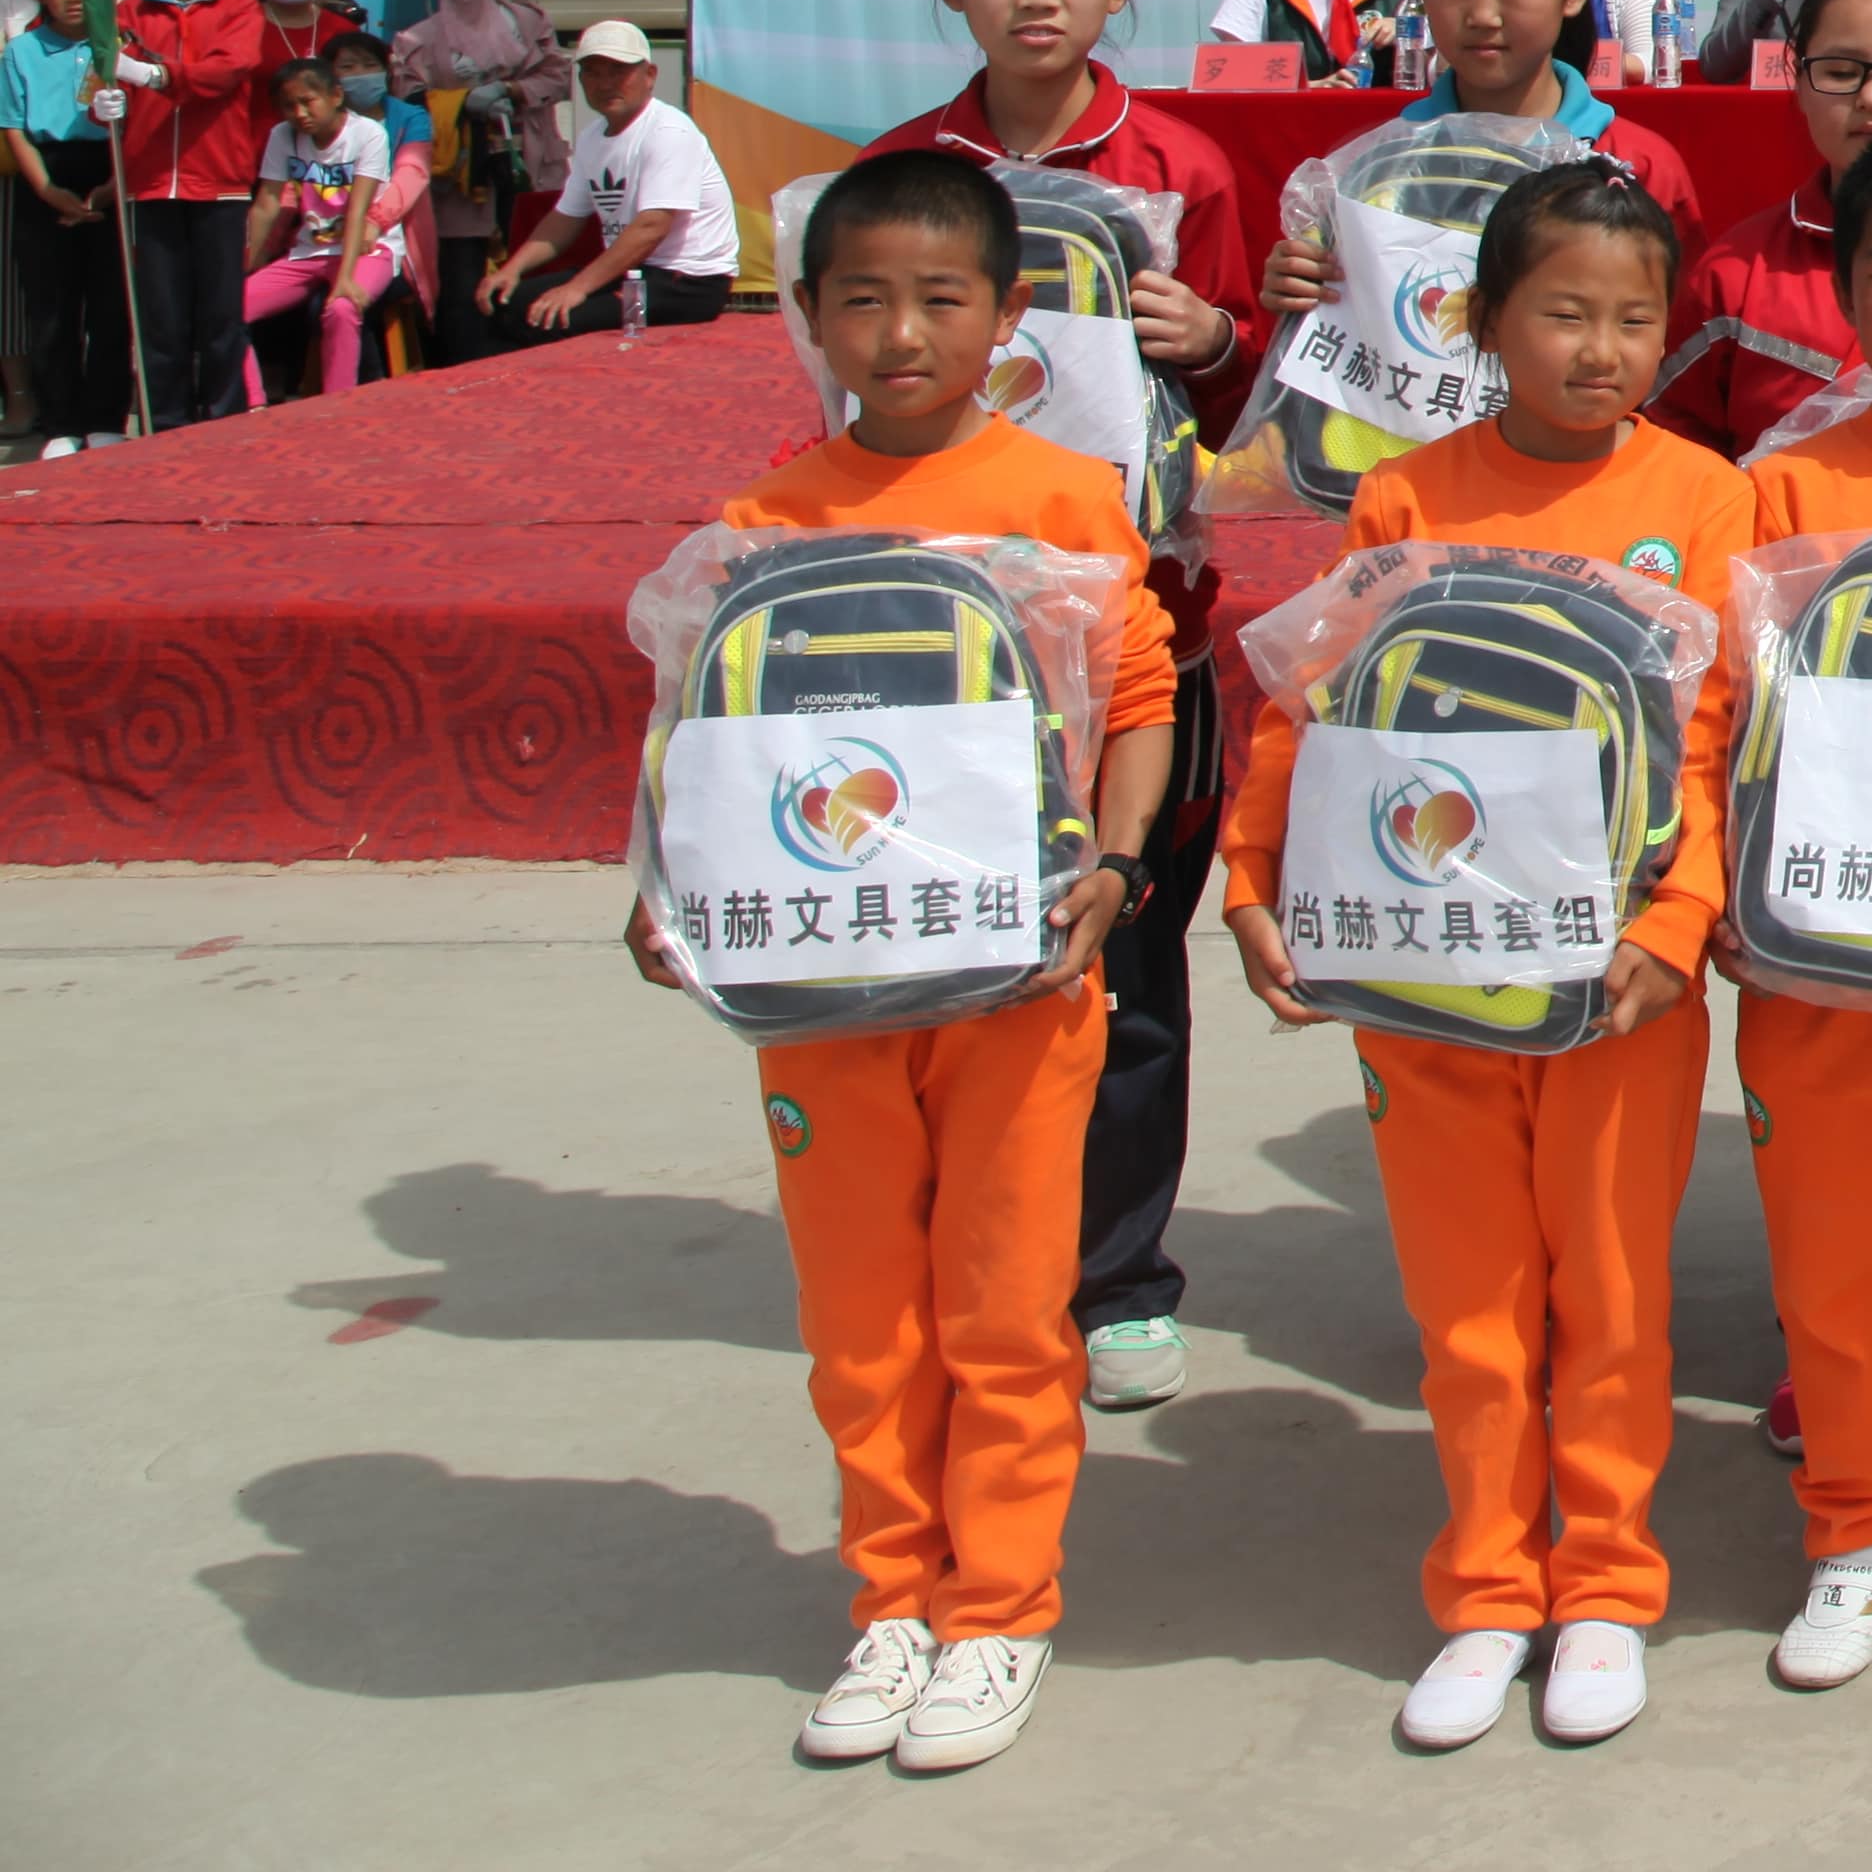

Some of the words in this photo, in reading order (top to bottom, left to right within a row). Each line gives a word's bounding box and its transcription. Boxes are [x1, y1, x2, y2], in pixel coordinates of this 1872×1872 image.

[680, 872, 1026, 952] 尚赫文具套组
[1290, 891, 1604, 954] 尚赫文具套组
[1822, 1585, 1846, 1608] 道
